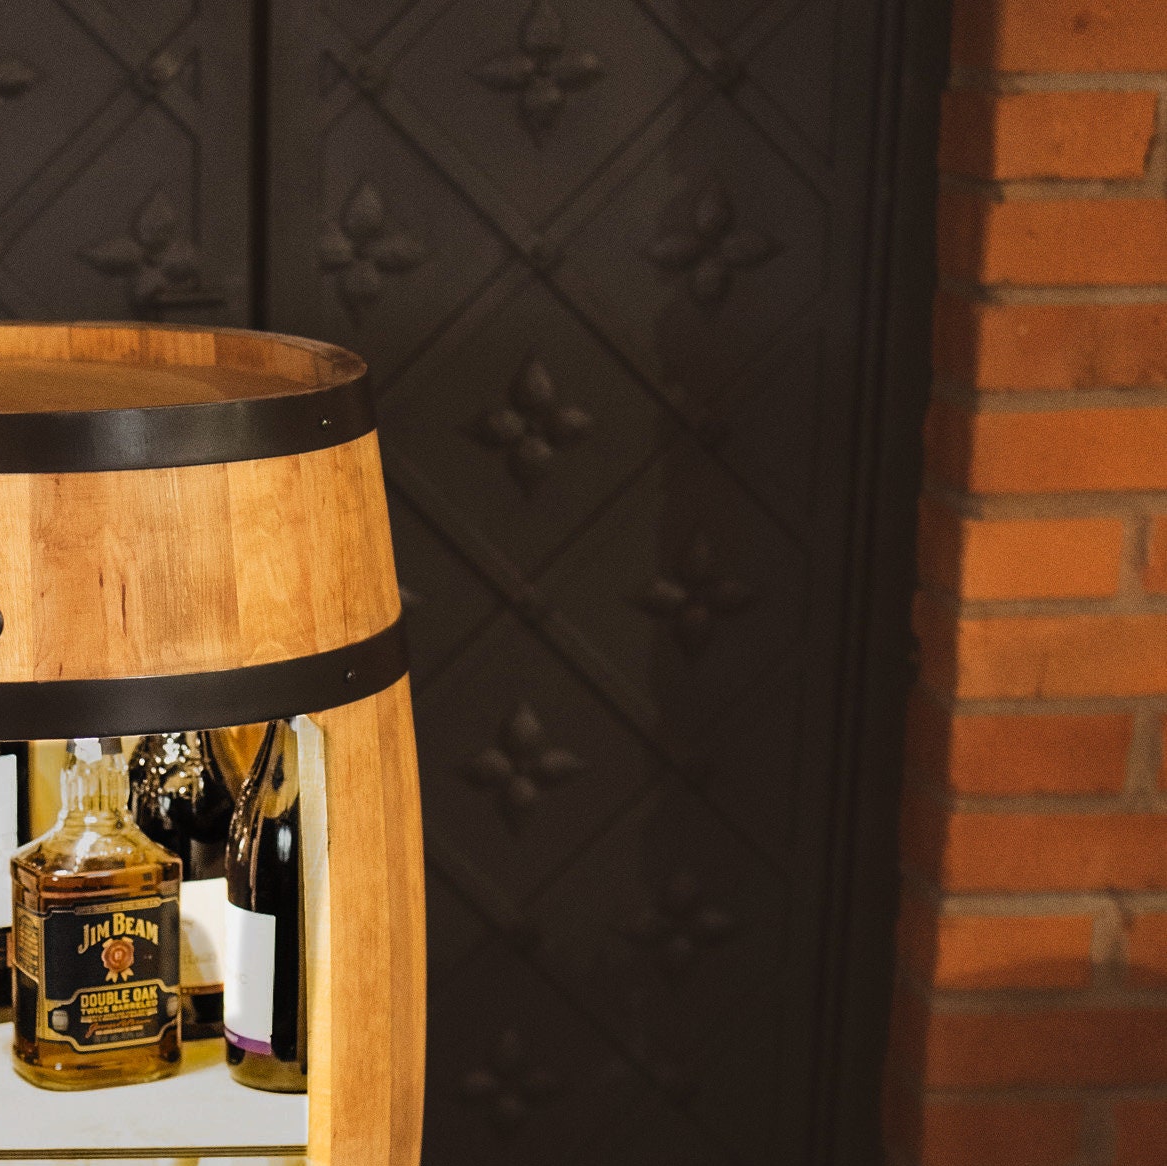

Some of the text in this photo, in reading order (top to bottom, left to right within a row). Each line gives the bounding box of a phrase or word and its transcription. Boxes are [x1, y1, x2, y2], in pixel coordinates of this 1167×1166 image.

[77, 920, 111, 955] JIM
[113, 912, 159, 946] BEAM
[80, 984, 158, 1009] DOUBLE OAK
[80, 1006, 110, 1016] TWICE
